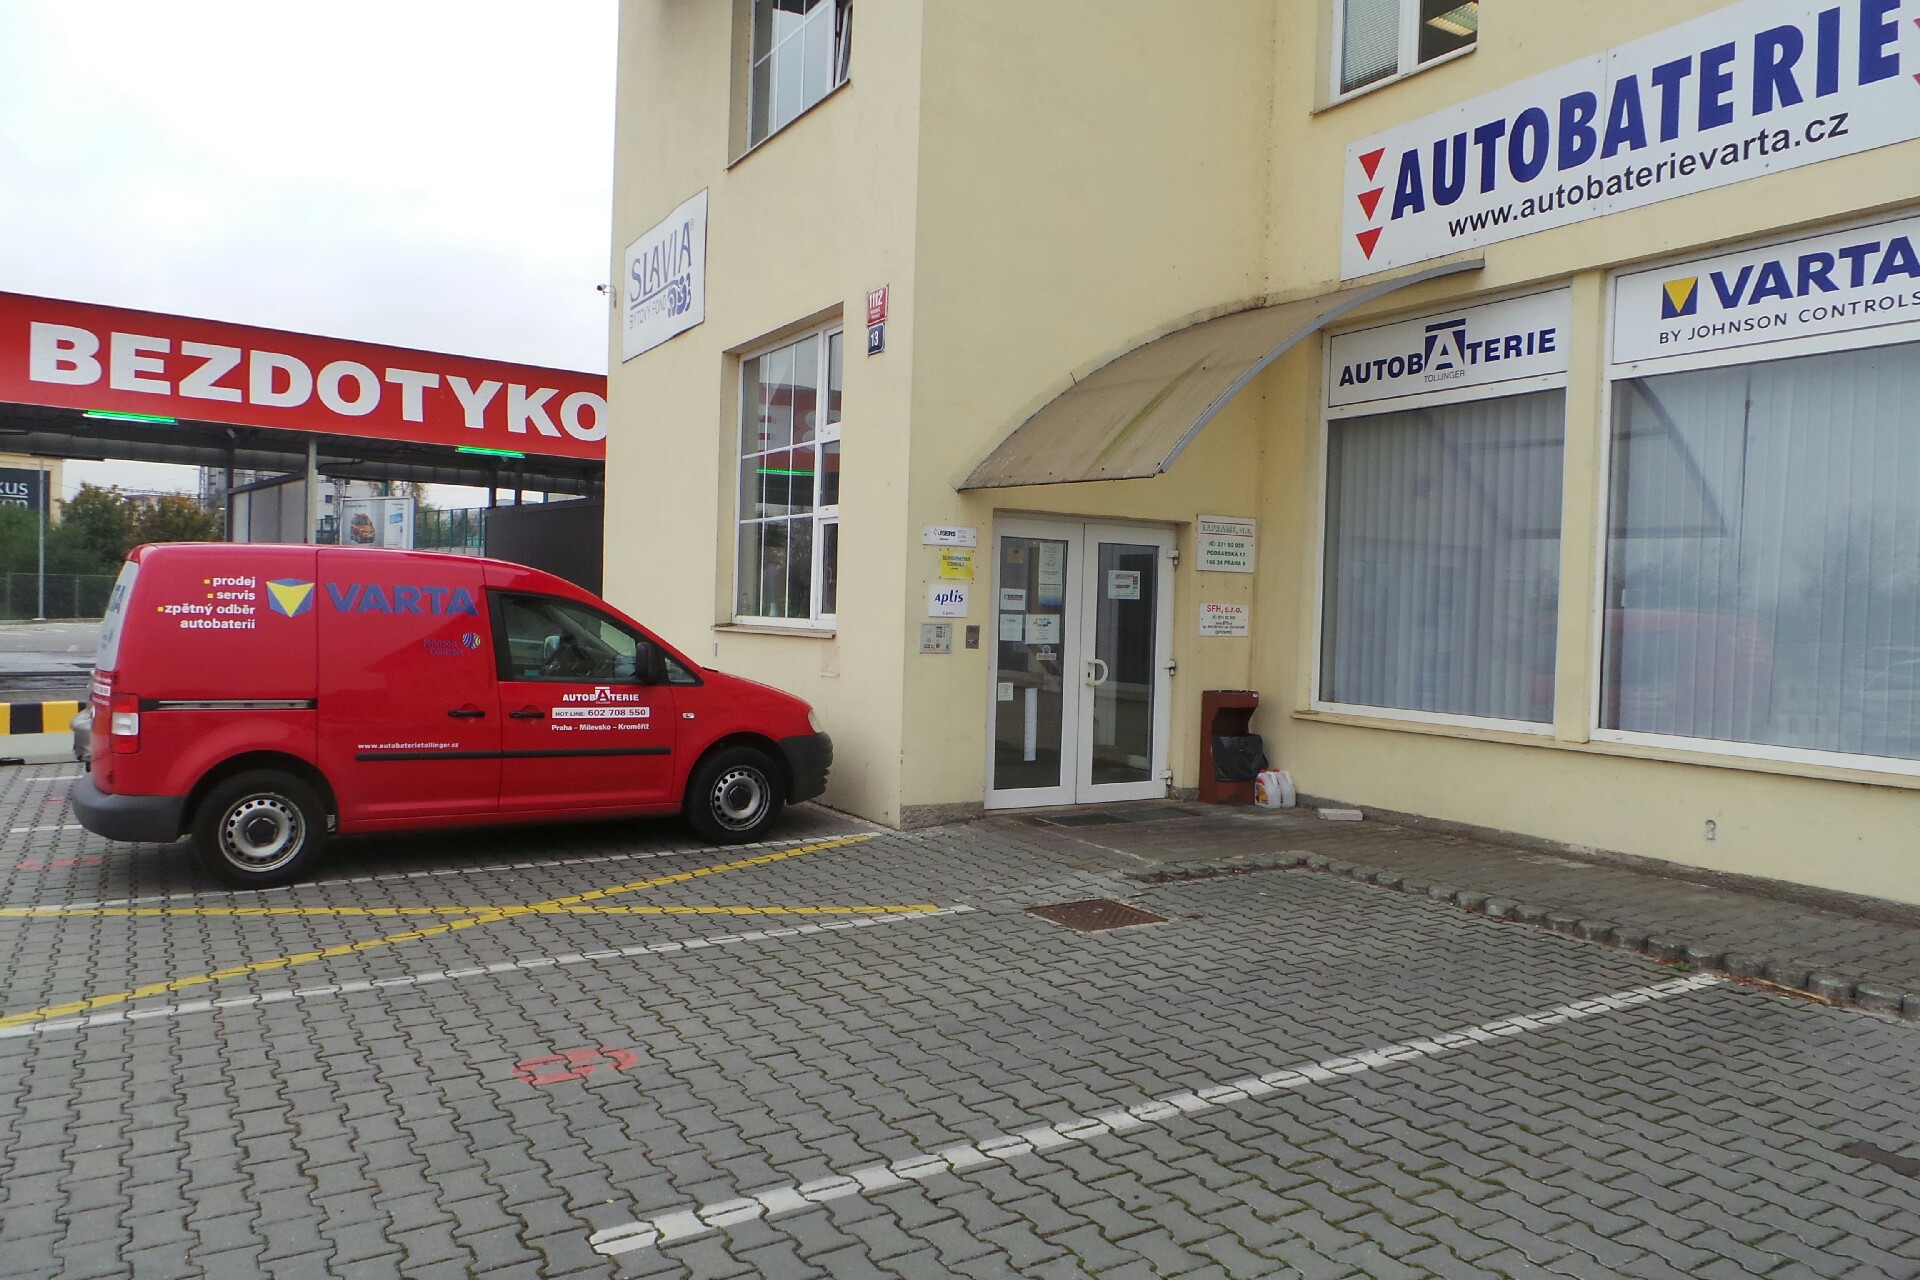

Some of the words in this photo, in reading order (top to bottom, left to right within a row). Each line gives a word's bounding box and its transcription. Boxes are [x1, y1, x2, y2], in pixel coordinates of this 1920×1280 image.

[1391, 0, 1901, 221] AUTOBATERIE
[1448, 112, 1850, 238] www.autobaterievarta.cz
[630, 222, 692, 302] SLAVIA
[1709, 236, 1920, 310] VARTA
[869, 290, 883, 309] 1112
[1659, 329, 1682, 345] BY
[1687, 312, 1788, 341] JOHNSON
[1798, 291, 1920, 323] CONTROLS
[871, 331, 879, 346] 13
[1339, 318, 1557, 387] AUTOBATERIE
[29, 320, 607, 443] BEZDOTYKO
[1424, 369, 1466, 383] TOLLINGER
[212, 576, 256, 588] prodej
[216, 590, 256, 600] servis
[325, 582, 479, 617] VARTA
[164, 603, 213, 616] zpětný
[216, 604, 256, 614] odběr
[180, 618, 256, 629] autobaterií
[562, 686, 640, 701] AUTOBATERIE
[588, 709, 606, 717] 602
[608, 709, 626, 717] 708
[628, 709, 646, 717] 550
